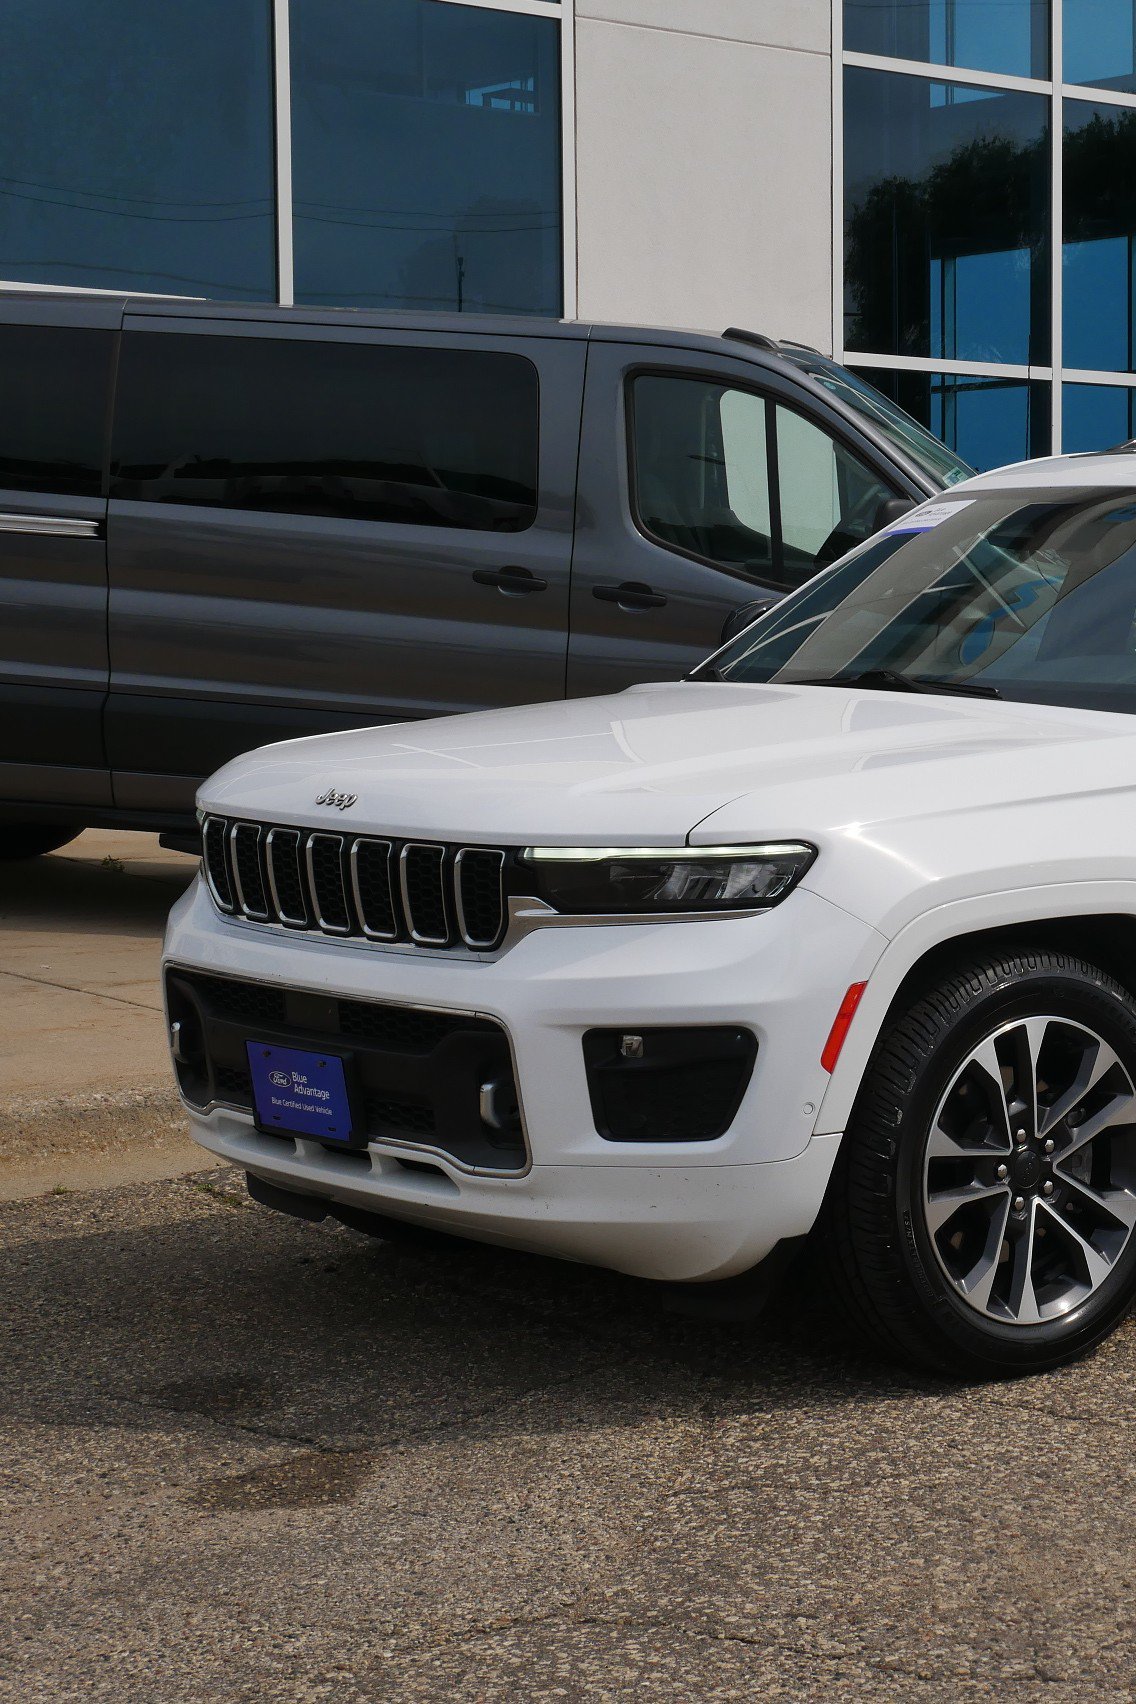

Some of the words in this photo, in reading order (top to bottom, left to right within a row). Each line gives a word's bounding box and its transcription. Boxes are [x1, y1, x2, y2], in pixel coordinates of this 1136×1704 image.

[315, 788, 358, 811] Jeep
[273, 1072, 287, 1085] Ford
[291, 1071, 307, 1084] Blue
[294, 1083, 330, 1100] Advantage
[271, 1096, 282, 1106] Blue
[282, 1099, 302, 1110] Certified
[302, 1103, 315, 1112] Used
[315, 1105, 333, 1116] Vehicle
